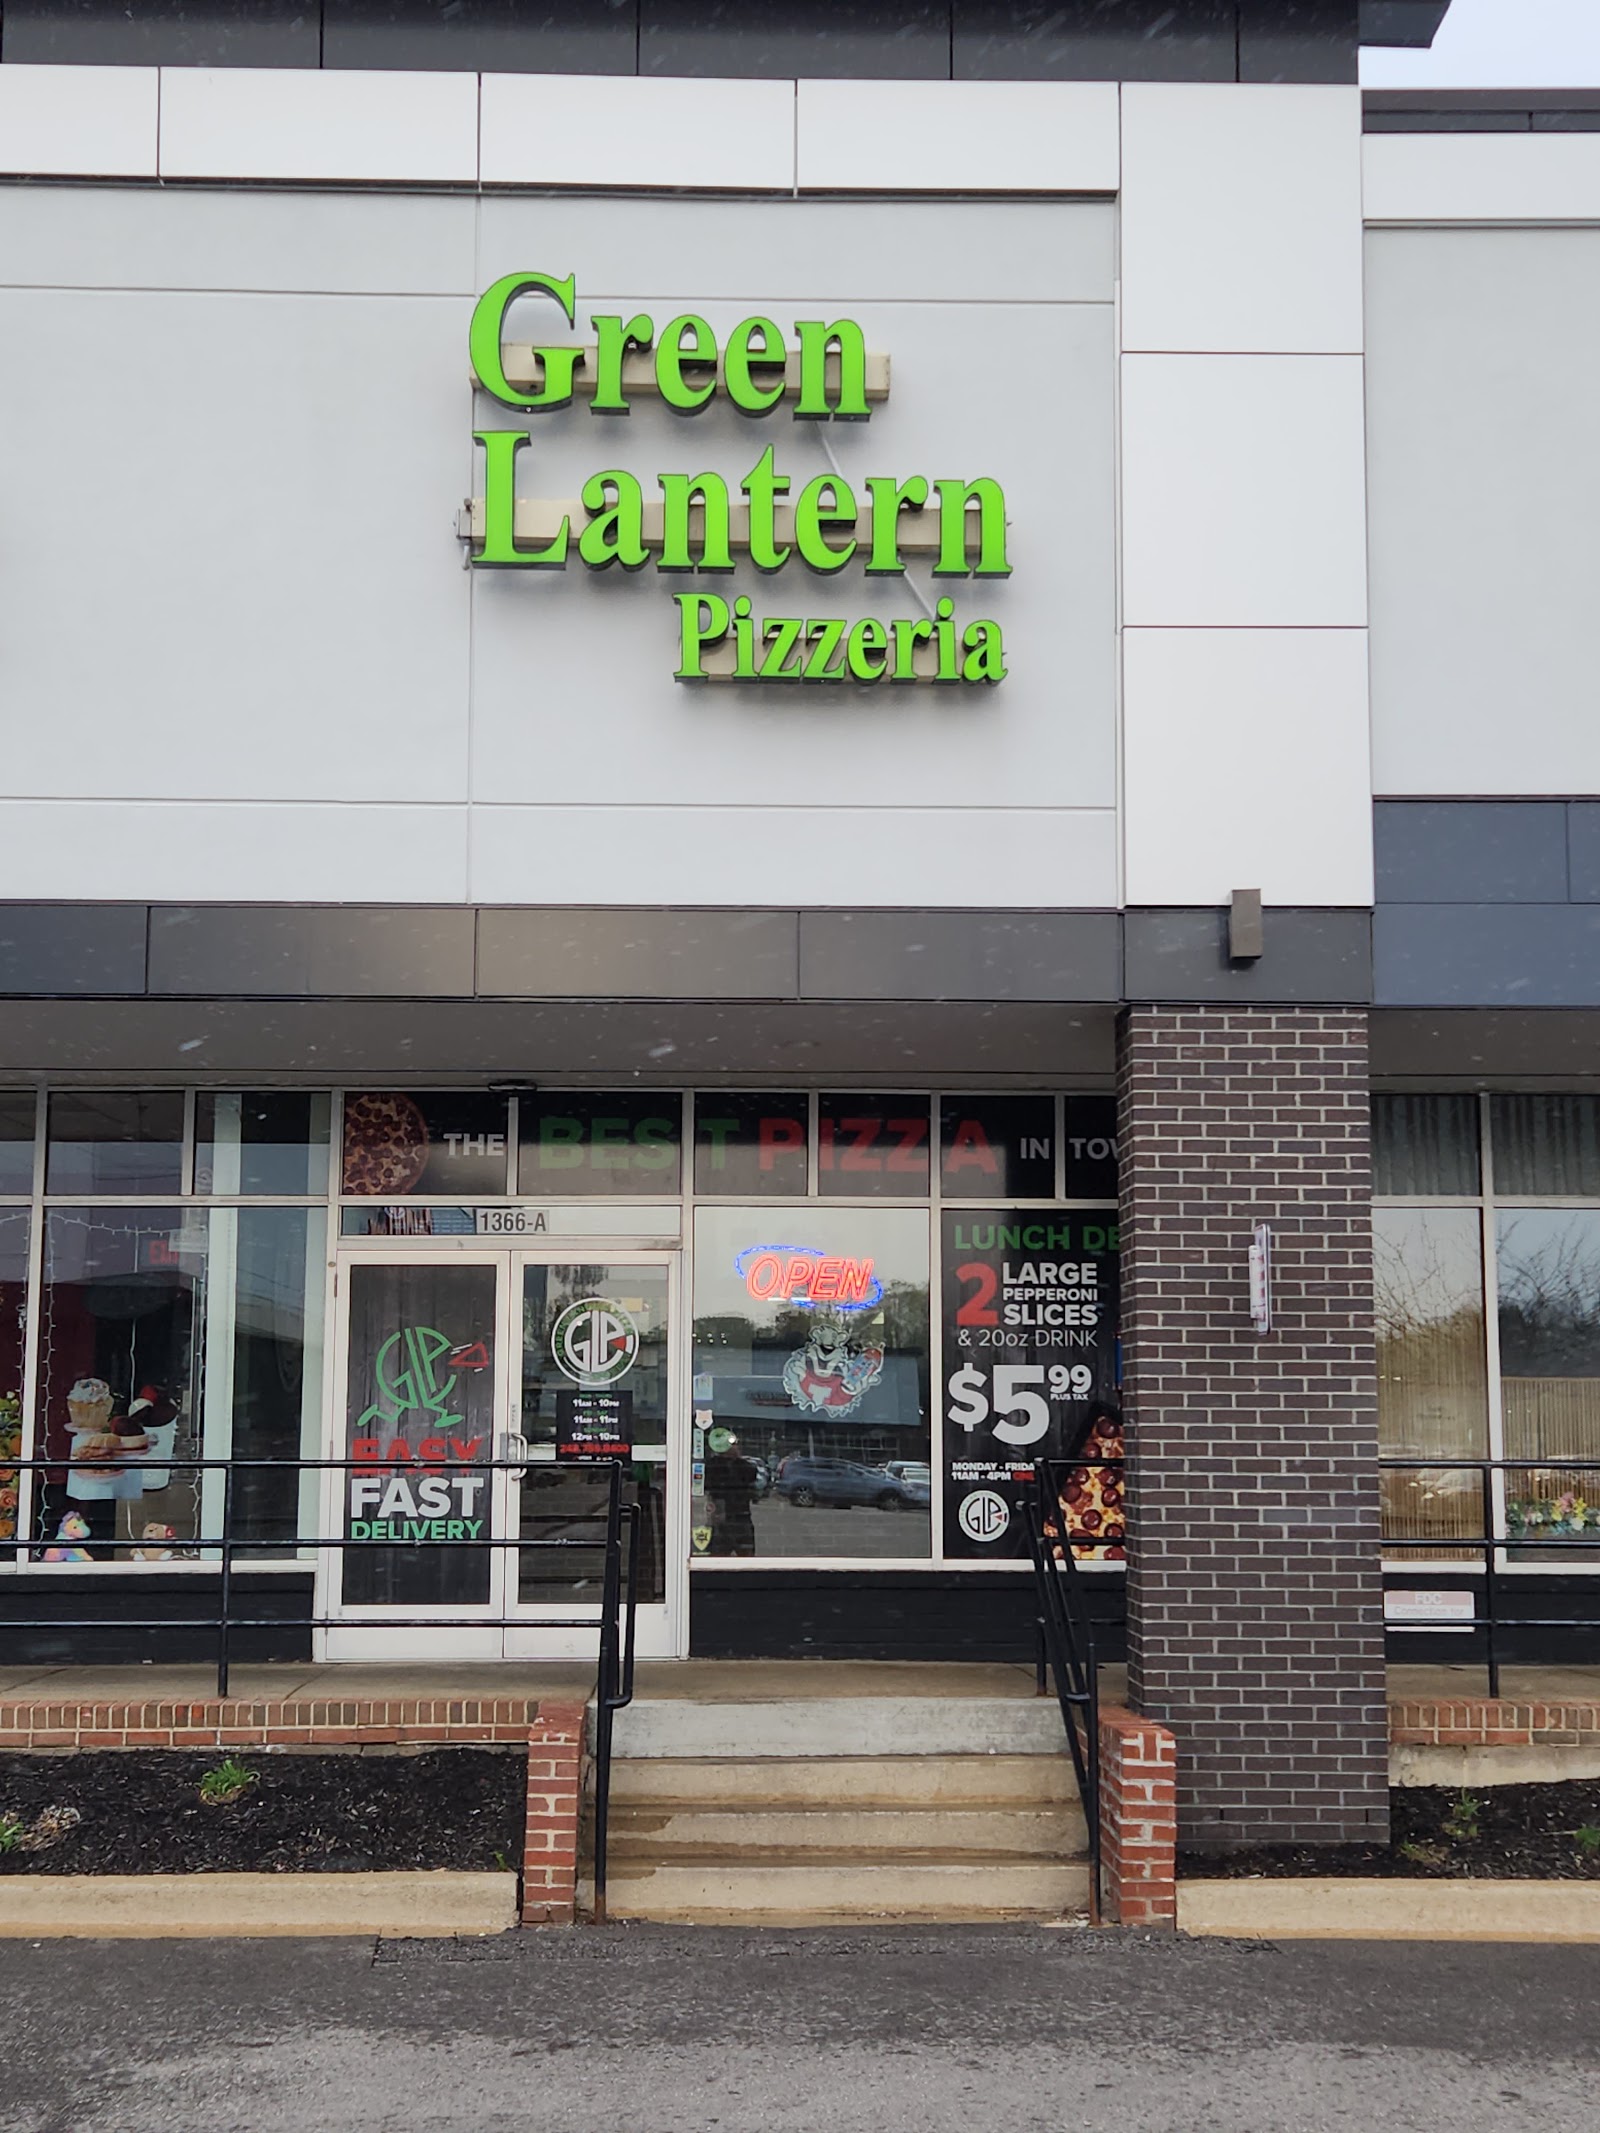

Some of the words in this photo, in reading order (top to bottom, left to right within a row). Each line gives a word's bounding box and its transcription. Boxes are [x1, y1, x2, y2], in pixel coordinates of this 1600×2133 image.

[470, 271, 872, 420] Green
[471, 430, 1013, 578] Lantern
[673, 592, 1008, 683] Pizzeria
[443, 1133, 505, 1156] THE
[539, 1116, 740, 1170] BEST
[758, 1117, 999, 1173] PIZZA
[1020, 1138, 1050, 1159] IN
[479, 1211, 547, 1232] 1366-A
[954, 1224, 1071, 1250] LUNCH
[1083, 1225, 1120, 1250] DE
[747, 1254, 874, 1301] OPEN
[1002, 1262, 1098, 1285] LARGE
[955, 1262, 999, 1327] 2
[1002, 1287, 1098, 1302] PEPPERONI
[1003, 1303, 1099, 1326] SLICES
[957, 1328, 972, 1347] &
[978, 1329, 1029, 1347] 20oz
[1034, 1329, 1098, 1348] DRINK
[1050, 1393, 1071, 1401] PLUS
[1072, 1393, 1088, 1401] TAX
[351, 1438, 483, 1475] EASY
[951, 1462, 998, 1471] MONDAY
[1005, 1462, 1035, 1472] FRIDA
[951, 1471, 979, 1480] 11AM
[986, 1471, 1011, 1481] 4PM
[351, 1477, 485, 1518] FAST
[351, 1519, 483, 1540] DELIVERY
[1415, 1593, 1442, 1605] FDC
